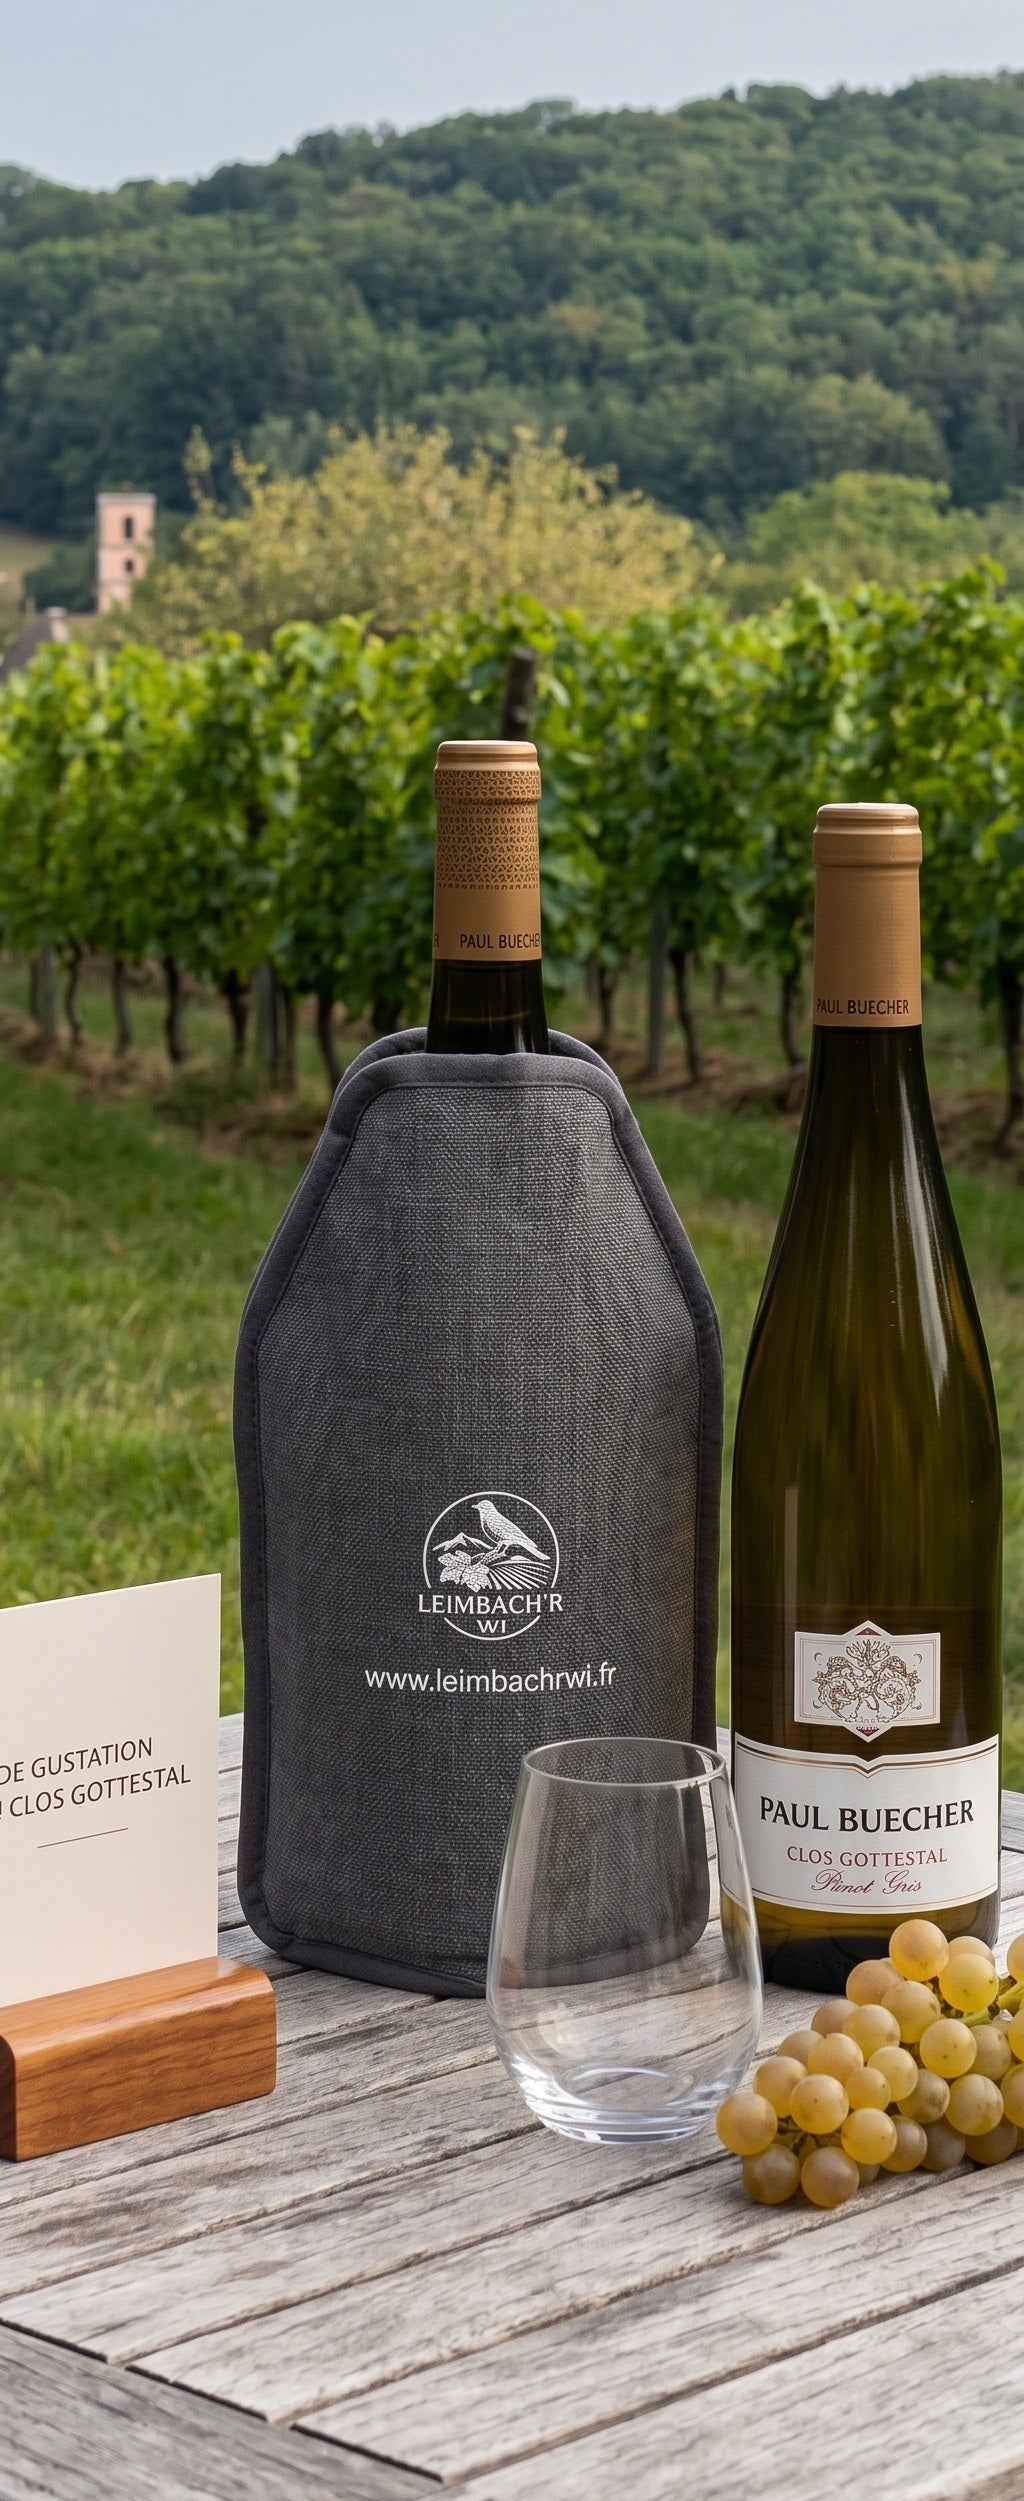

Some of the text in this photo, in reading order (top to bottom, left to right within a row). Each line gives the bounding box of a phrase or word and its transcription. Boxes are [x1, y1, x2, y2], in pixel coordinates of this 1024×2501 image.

[460, 933, 494, 949] PAUL
[816, 998, 909, 1015] PAUL BUECHER
[418, 1593, 563, 1614] LEIMBACH'R
[476, 1619, 506, 1634] WI
[364, 1661, 617, 1693] www.leimbachrwi.fr
[31, 1737, 152, 1778] GUSTATION
[9, 1788, 65, 1817] CLOS
[71, 1764, 191, 1805] GOTTESTAL
[760, 1796, 974, 1833] PAUL BUECHER
[786, 1845, 947, 1868] CLOS GOTTESTAL
[882, 1869, 922, 1895] Gris
